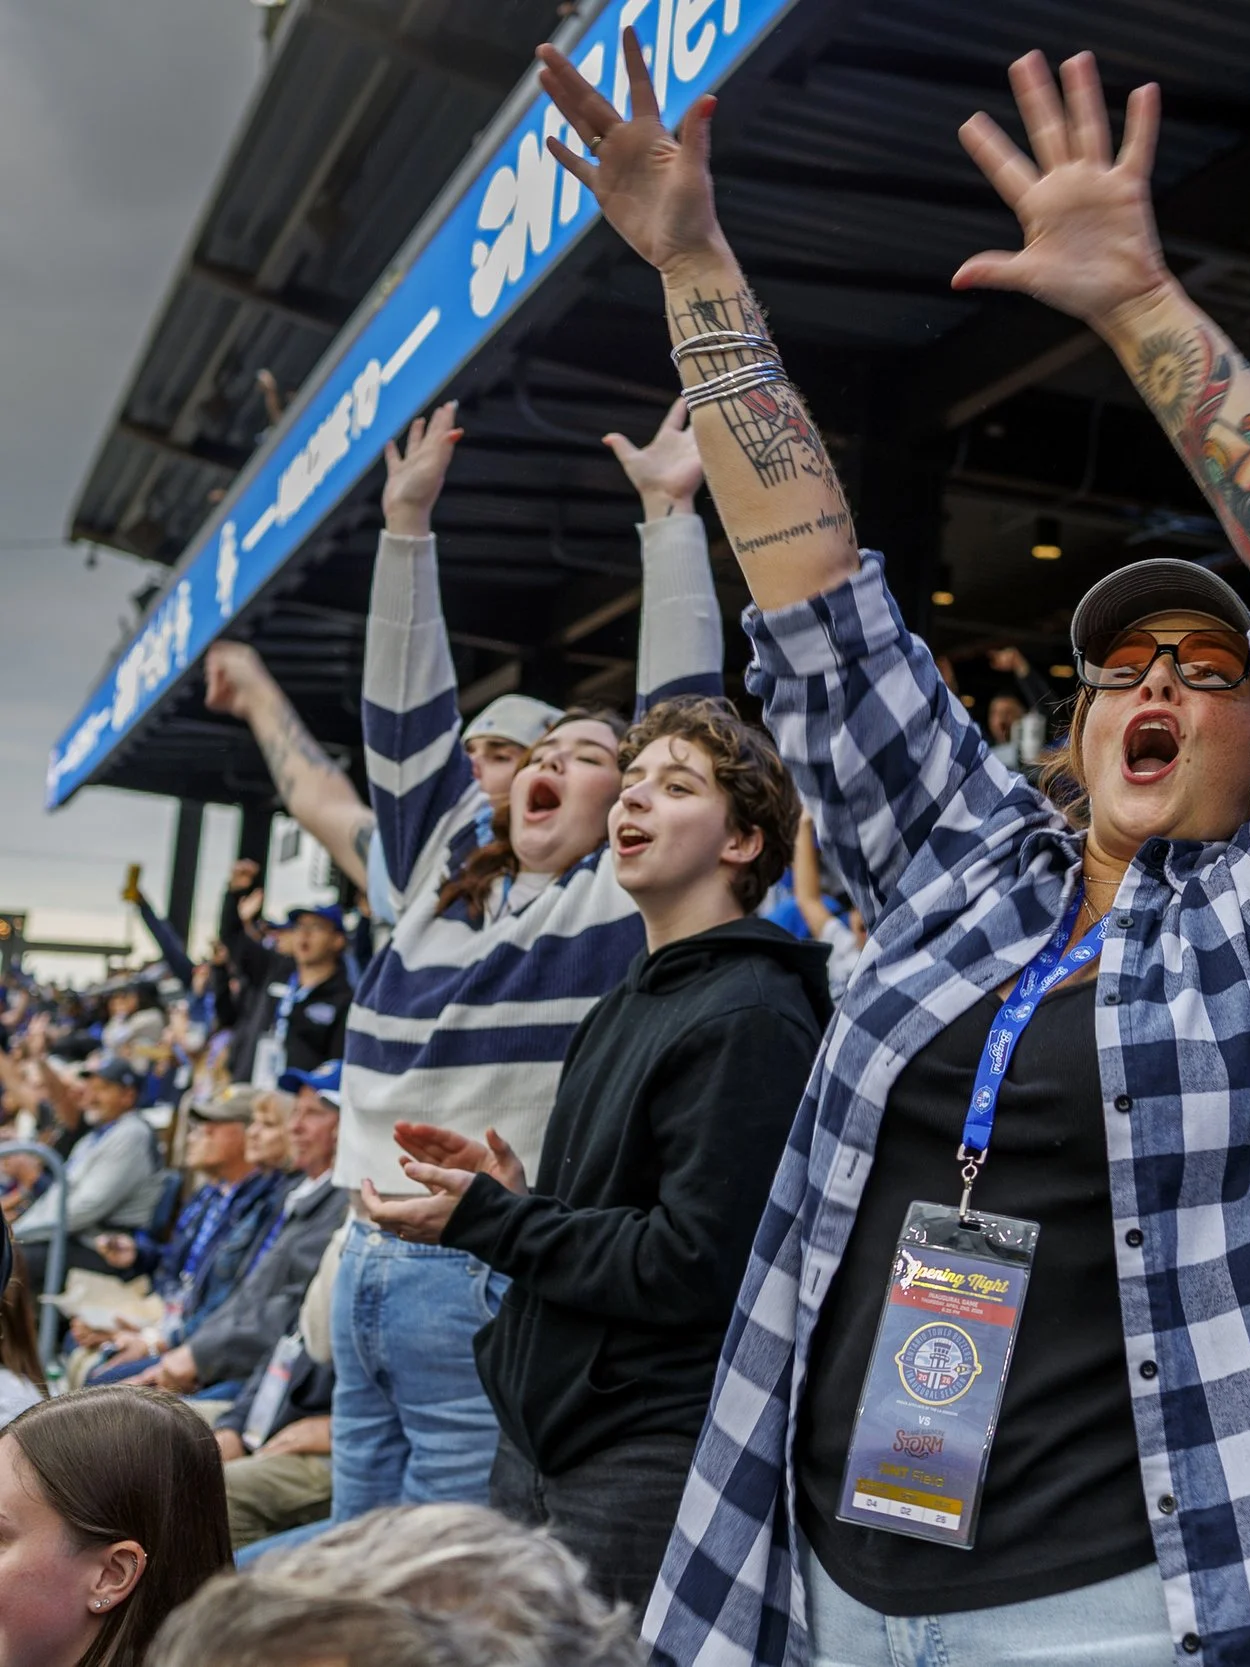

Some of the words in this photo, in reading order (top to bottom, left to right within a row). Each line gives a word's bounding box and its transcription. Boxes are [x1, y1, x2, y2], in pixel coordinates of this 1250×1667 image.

[968, 1273, 1010, 1294] Night
[928, 1327, 951, 1337] TOWER
[905, 1370, 938, 1399] INAUGURAL
[941, 1377, 967, 1399] SEASON
[918, 1415, 931, 1426] VS
